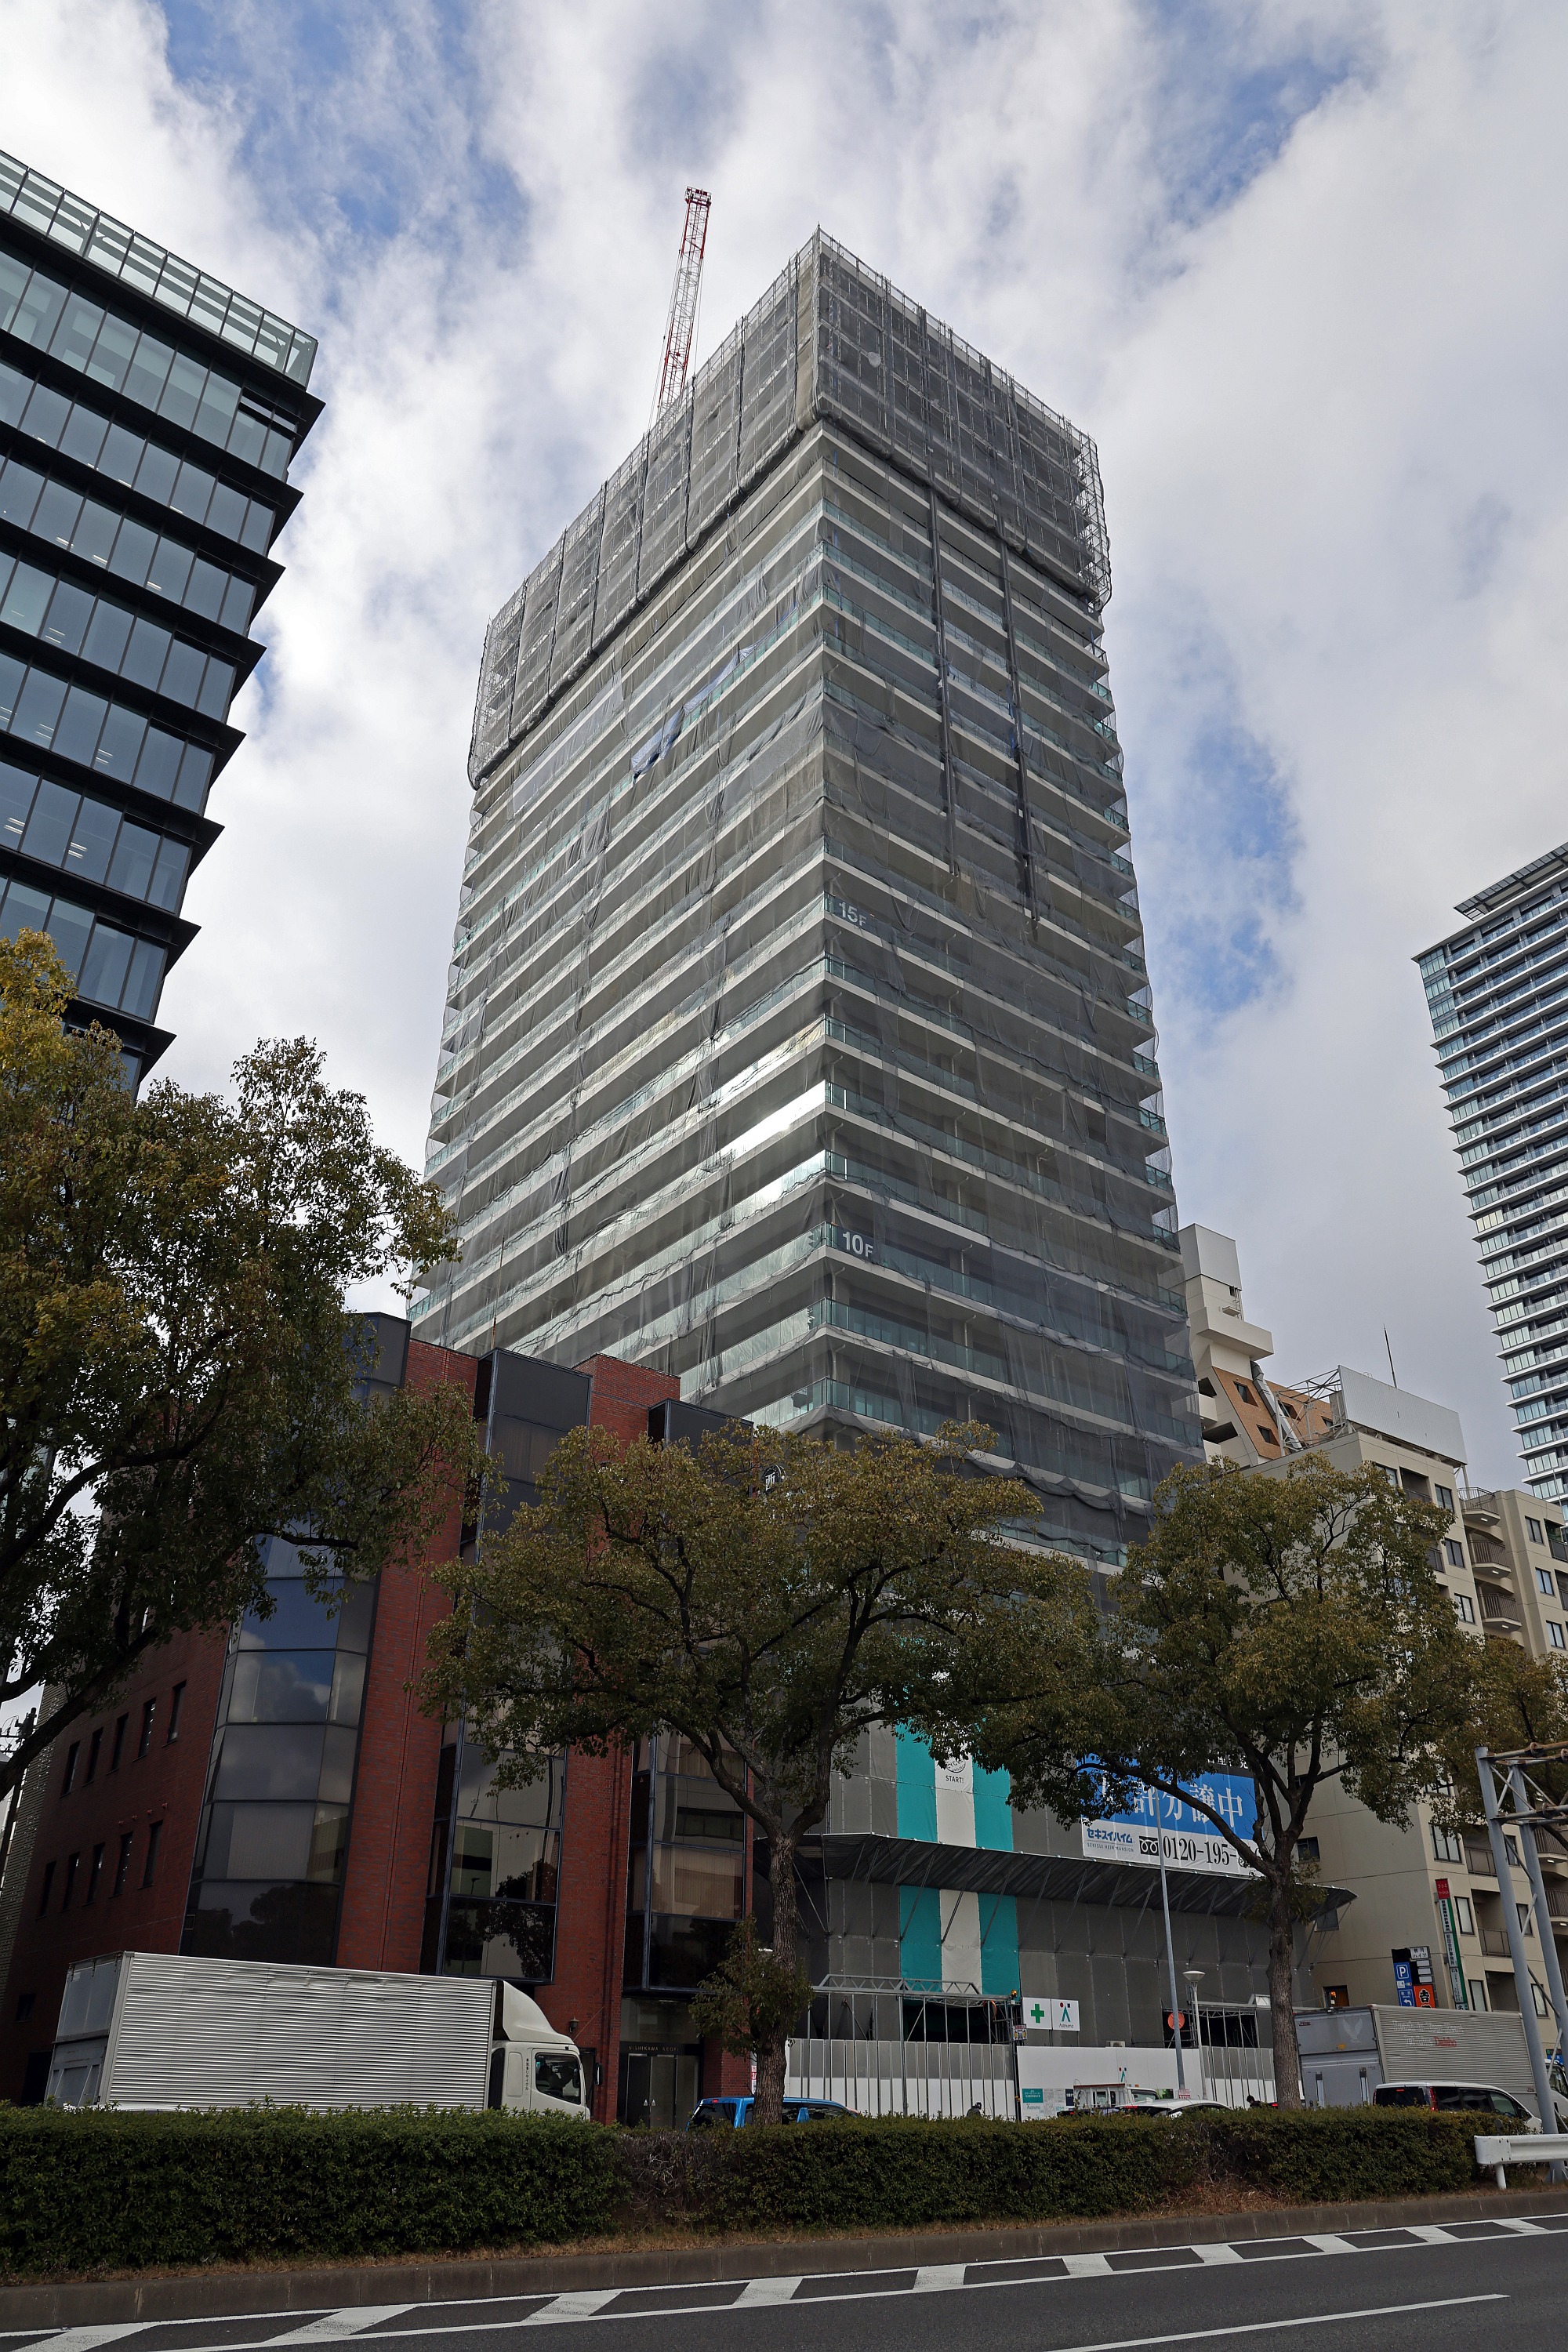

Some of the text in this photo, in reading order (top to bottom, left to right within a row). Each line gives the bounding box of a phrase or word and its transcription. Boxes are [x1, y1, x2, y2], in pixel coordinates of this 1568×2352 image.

[839, 902, 867, 927] 15F
[842, 1231, 873, 1258] 10F
[946, 1775, 964, 1784] START!
[1087, 1828, 1133, 1844] セキスイハイム
[1399, 1966, 1406, 1977] P
